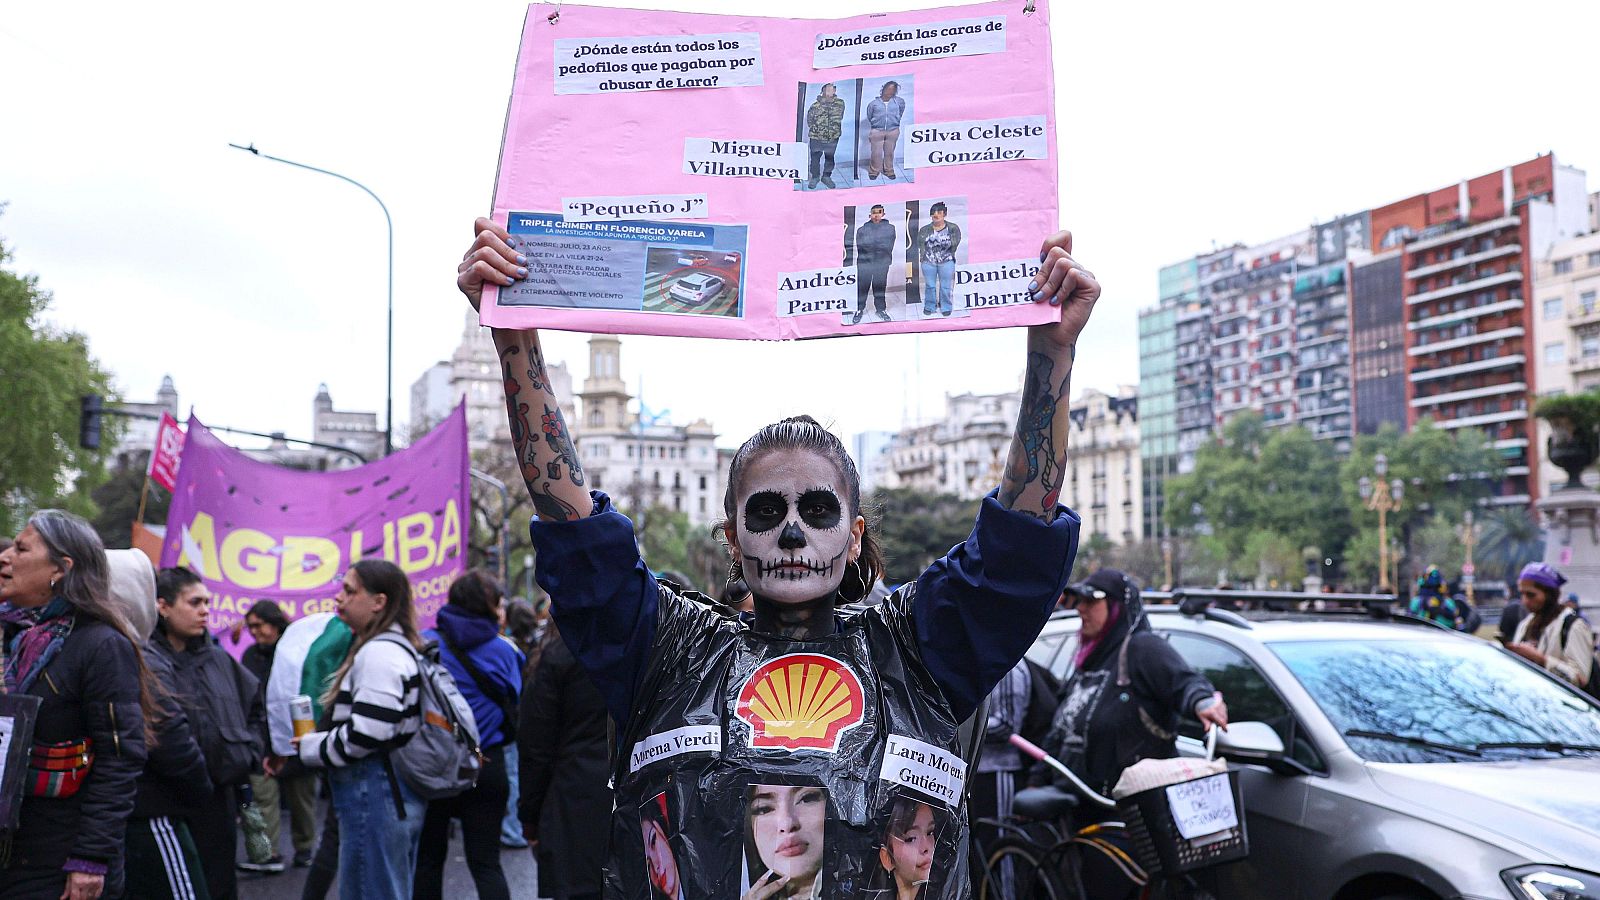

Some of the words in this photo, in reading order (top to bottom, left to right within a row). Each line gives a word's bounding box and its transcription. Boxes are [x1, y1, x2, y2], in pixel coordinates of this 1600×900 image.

[817, 34, 870, 50] ¿Dónde
[873, 30, 913, 44] están
[916, 28, 938, 40] las
[940, 25, 981, 37] caras
[985, 20, 1002, 32] de
[573, 42, 628, 58] ¿Dónde
[632, 41, 673, 54] están
[675, 41, 715, 53] todos
[718, 39, 740, 51] los
[860, 50, 885, 61] sus
[888, 42, 958, 60] asesinos?
[559, 61, 628, 76] pedofilos
[631, 60, 658, 74] que
[661, 58, 727, 72] pagaban
[729, 57, 755, 69] por
[599, 79, 652, 91] abusar
[656, 77, 674, 89] de
[676, 75, 719, 88] Lara?
[910, 128, 962, 144] Silva
[967, 124, 1044, 142] Celeste
[710, 140, 782, 160] Miguel
[928, 146, 1025, 165] González
[688, 161, 800, 179] Villanueva
[569, 201, 678, 218] “Pequeño
[680, 198, 704, 214] J”
[520, 219, 552, 228] TRIPLE
[555, 221, 592, 231] CRIMEN
[595, 224, 608, 232] EN
[610, 225, 665, 236] FLORENCIO
[668, 229, 706, 238] VARELA
[604, 231, 630, 239] APUNTA
[526, 241, 559, 249] NOMBRE:
[560, 243, 581, 251] JULIO,
[591, 244, 612, 252] AÑOS
[582, 270, 622, 278] POLICIALES
[778, 269, 857, 291] Andrés
[956, 262, 1040, 285] Daniela
[520, 288, 587, 298] EXTREMADAMENTE
[588, 291, 624, 299] VIOLENTO
[964, 289, 1035, 308] Ibarra
[787, 298, 848, 315] Parra
[177, 510, 341, 591] AGD
[673, 731, 719, 749] Verdi
[888, 741, 925, 764] Lara
[927, 752, 964, 781] Moen
[899, 767, 955, 800] Gutiérrz
